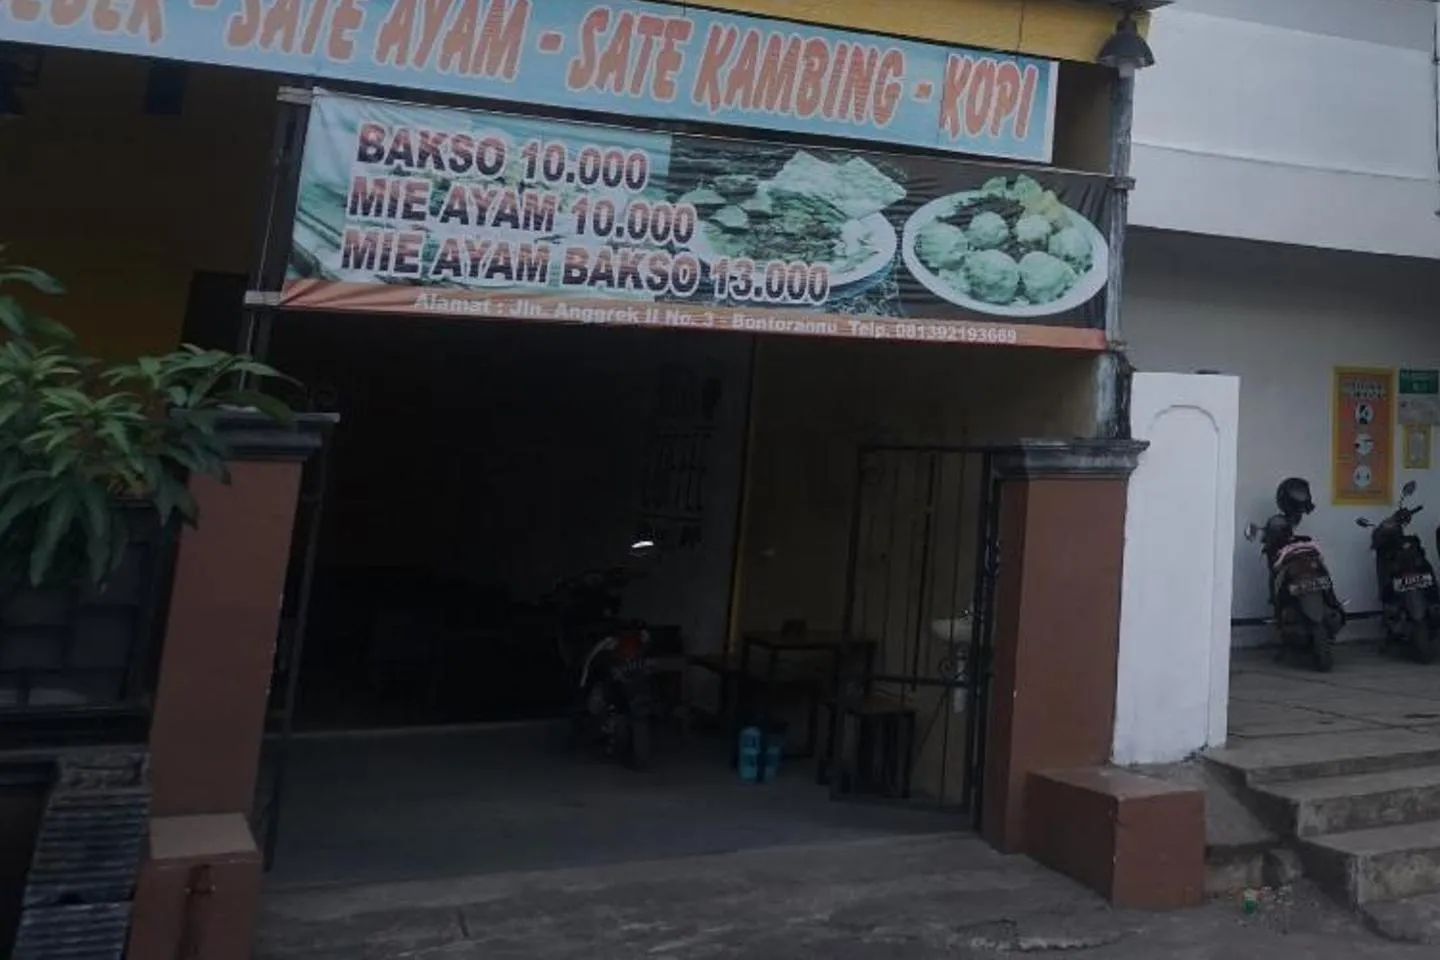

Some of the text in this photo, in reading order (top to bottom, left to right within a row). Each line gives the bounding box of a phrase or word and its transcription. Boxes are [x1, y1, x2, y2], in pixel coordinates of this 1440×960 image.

[567, 6, 694, 102] SATE
[693, 23, 904, 126] KAMBING
[939, 52, 1039, 140] KOPI
[356, 122, 650, 191] BAKSO 10.000
[348, 175, 697, 245] MIE AYAM 10.000
[340, 228, 830, 303] MIE AYAM BAKSO 13.000
[413, 293, 490, 314] Alamat
[554, 303, 641, 325] Anggrek
